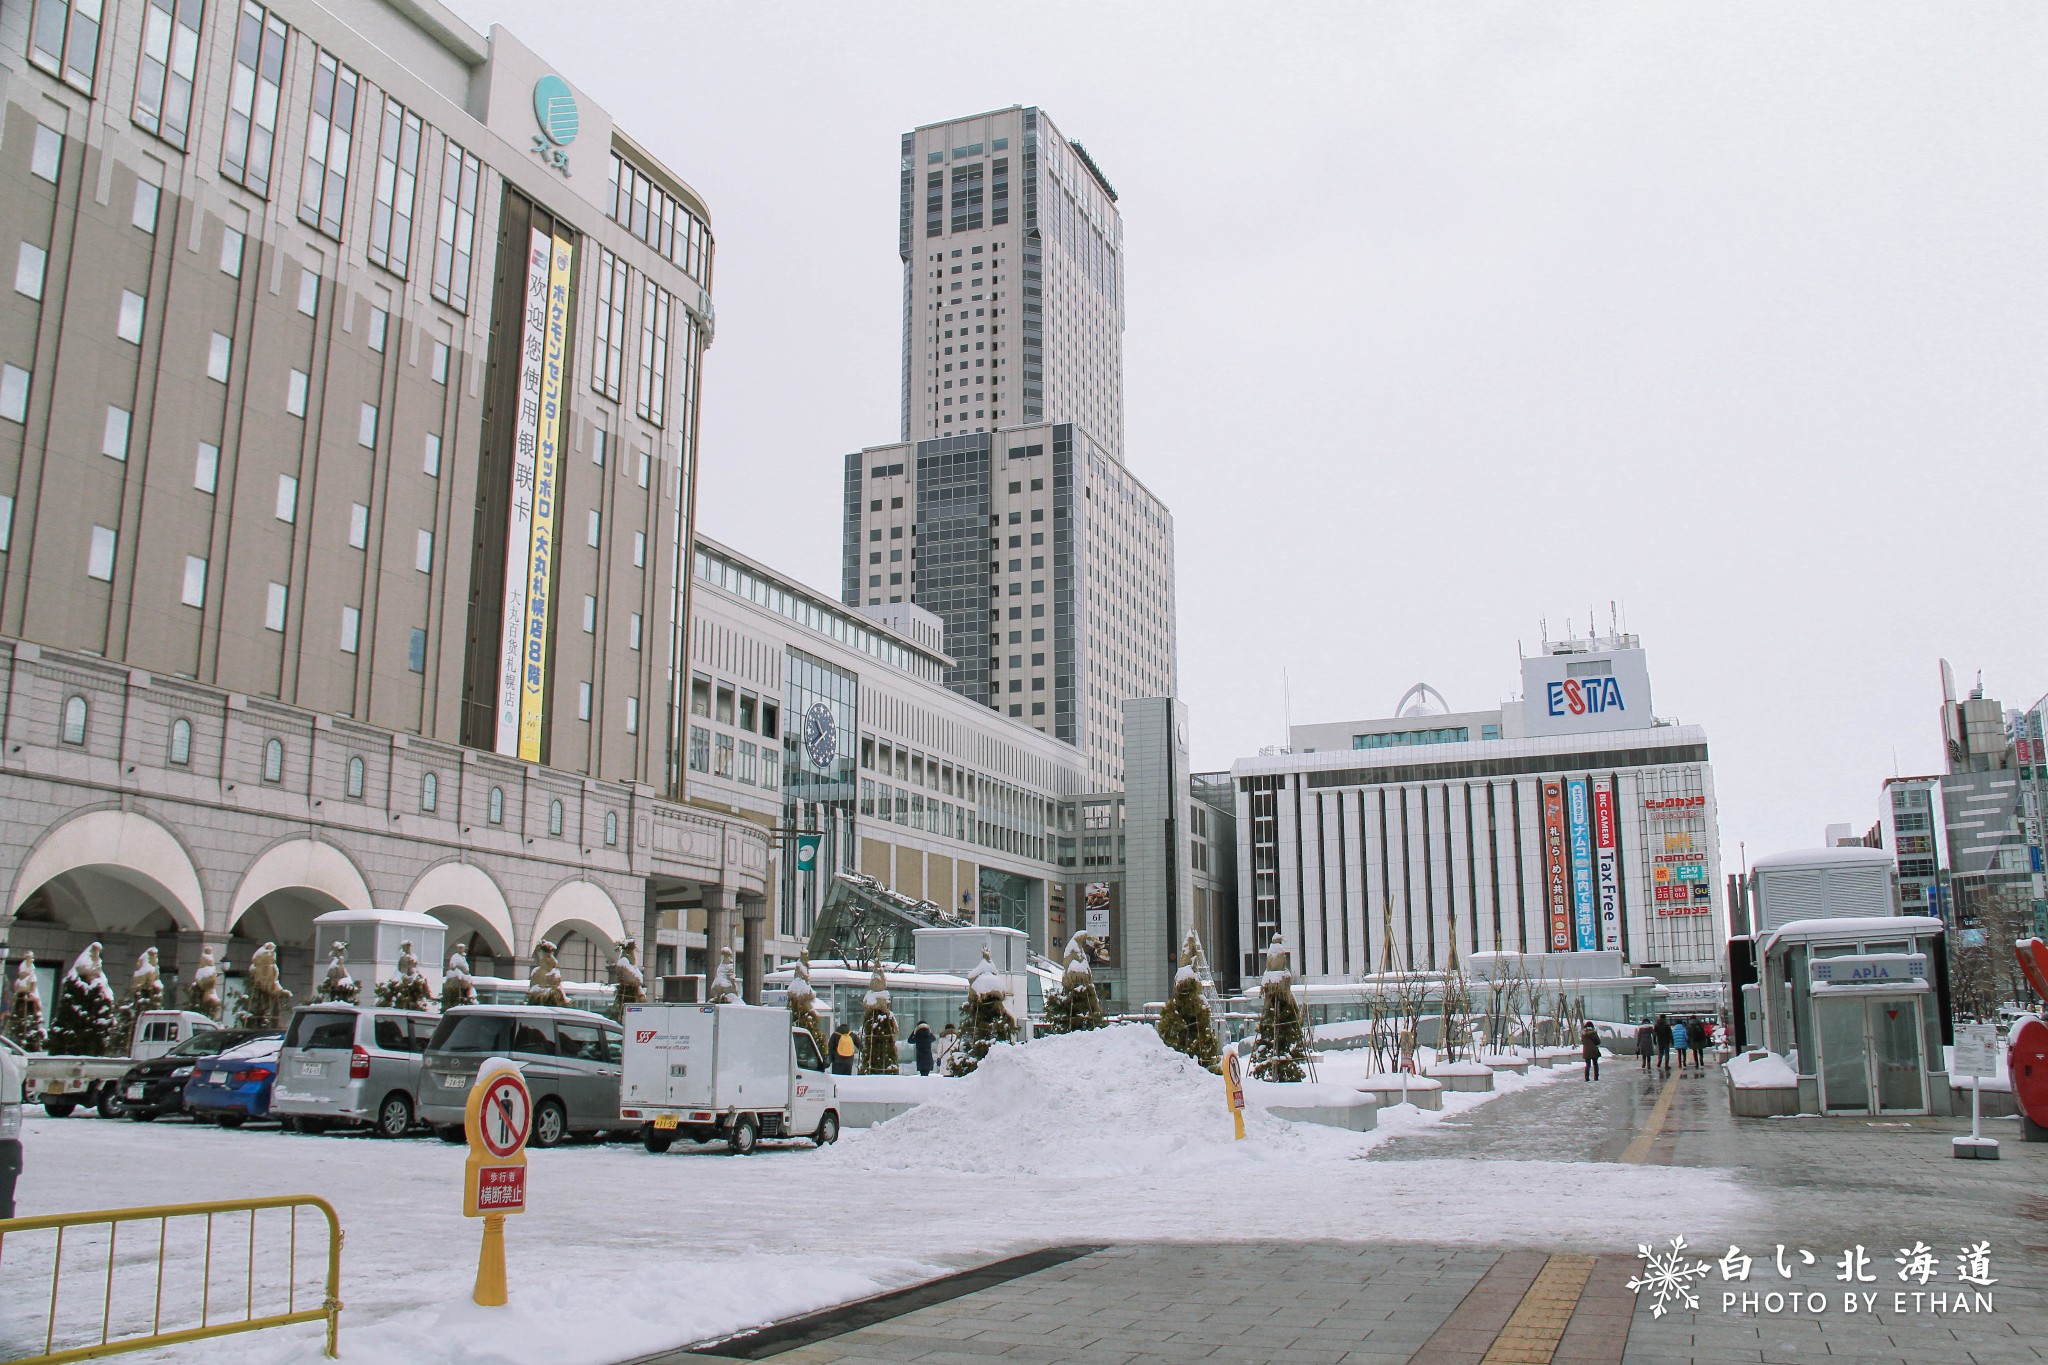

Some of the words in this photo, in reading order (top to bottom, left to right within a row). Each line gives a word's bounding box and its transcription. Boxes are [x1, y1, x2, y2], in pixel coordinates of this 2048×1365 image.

[514, 273, 548, 522] 欢迎您使用银联卡
[1547, 677, 1625, 716] ESTA
[1599, 794, 1607, 808] BIC
[1645, 796, 1705, 809] ビックカメラ
[1667, 810, 1701, 819] CAMERA
[1600, 809, 1610, 846] CAMERA
[1574, 826, 1587, 856] ナムコ
[1655, 853, 1704, 862] namco
[1601, 852, 1614, 882] Tax
[1680, 867, 1698, 875] ニトリ
[1602, 885, 1616, 921] Free
[1092, 913, 1103, 921] 6F
[1658, 906, 1708, 916] ビックカメラ
[1852, 963, 1889, 978] APIA
[490, 1171, 516, 1183] 歩行者
[480, 1184, 522, 1205] 横断禁止
